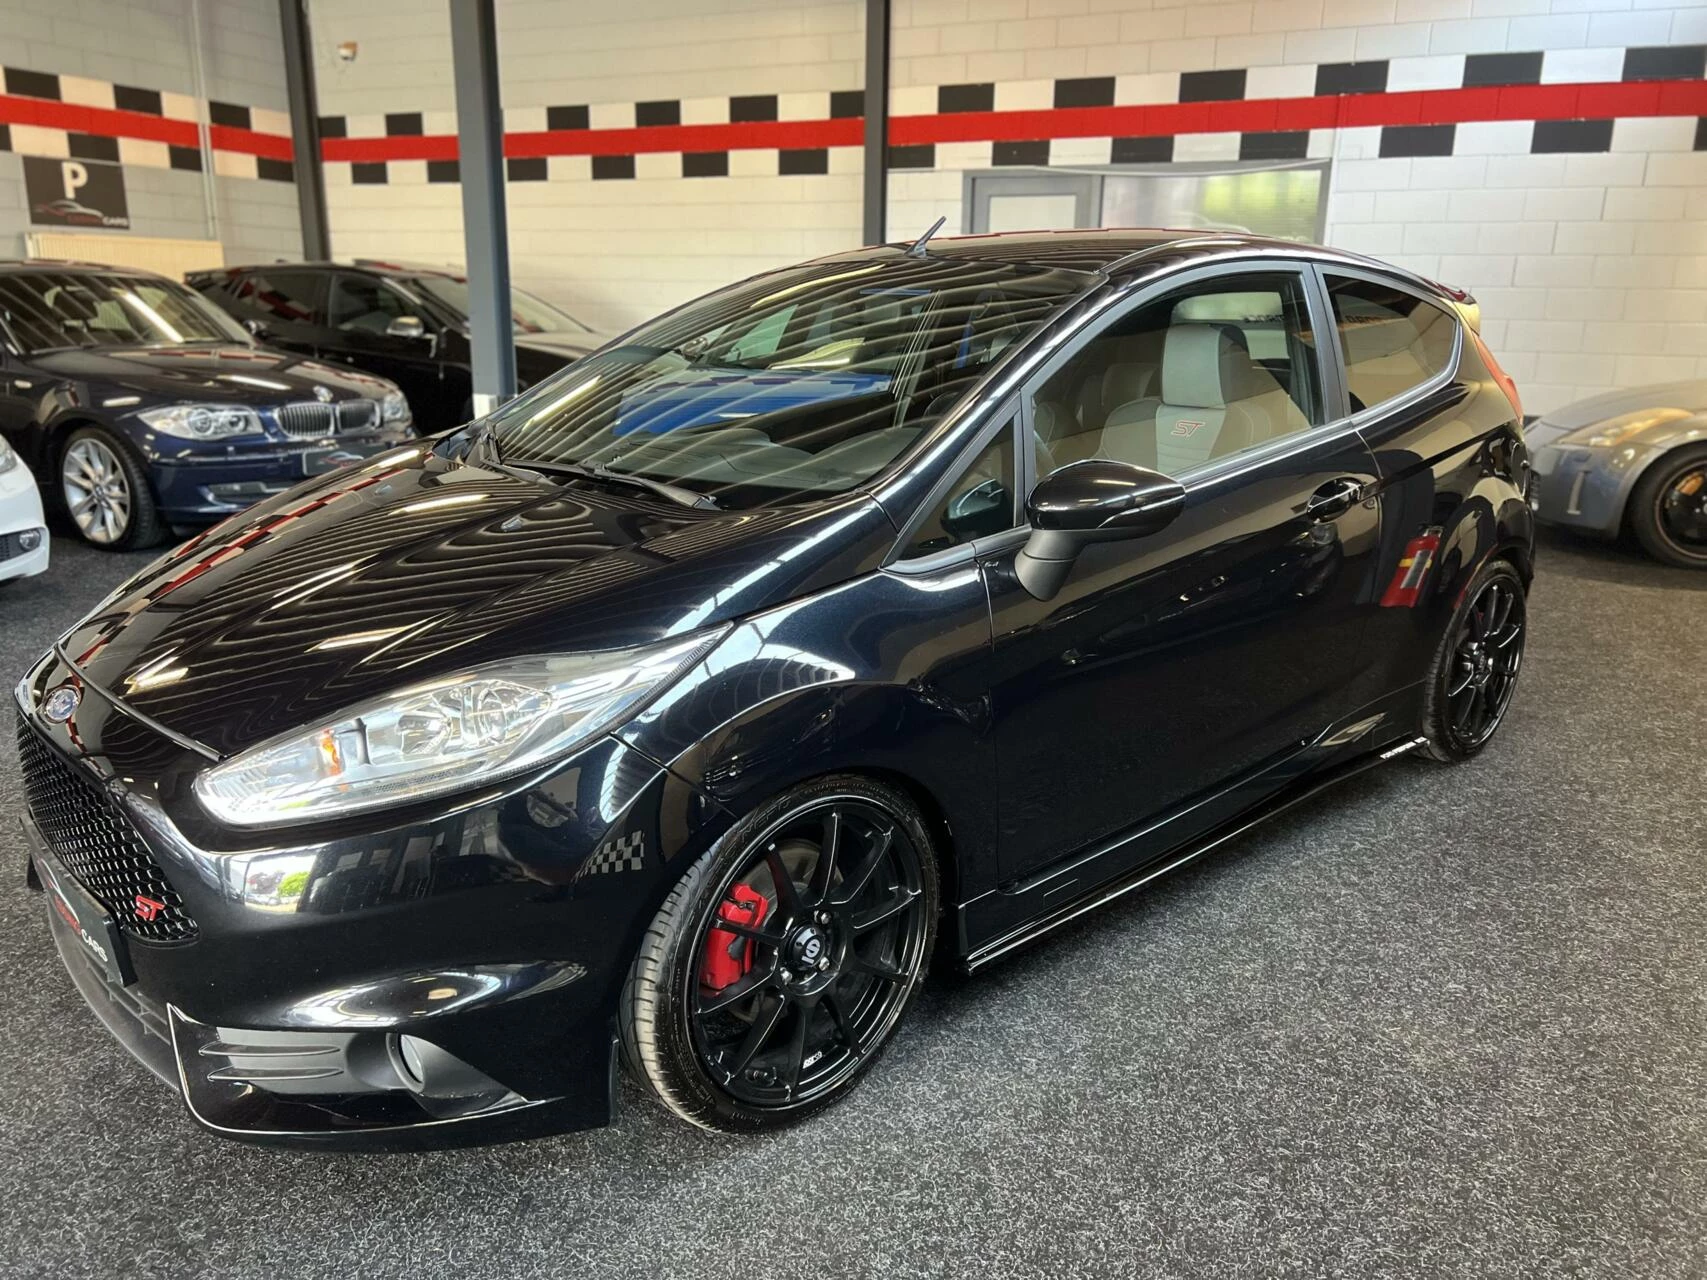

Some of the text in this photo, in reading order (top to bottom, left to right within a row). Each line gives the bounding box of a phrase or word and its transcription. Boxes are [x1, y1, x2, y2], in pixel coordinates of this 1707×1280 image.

[61, 161, 88, 199] P
[1171, 419, 1205, 439] ST
[135, 895, 165, 921] ST
